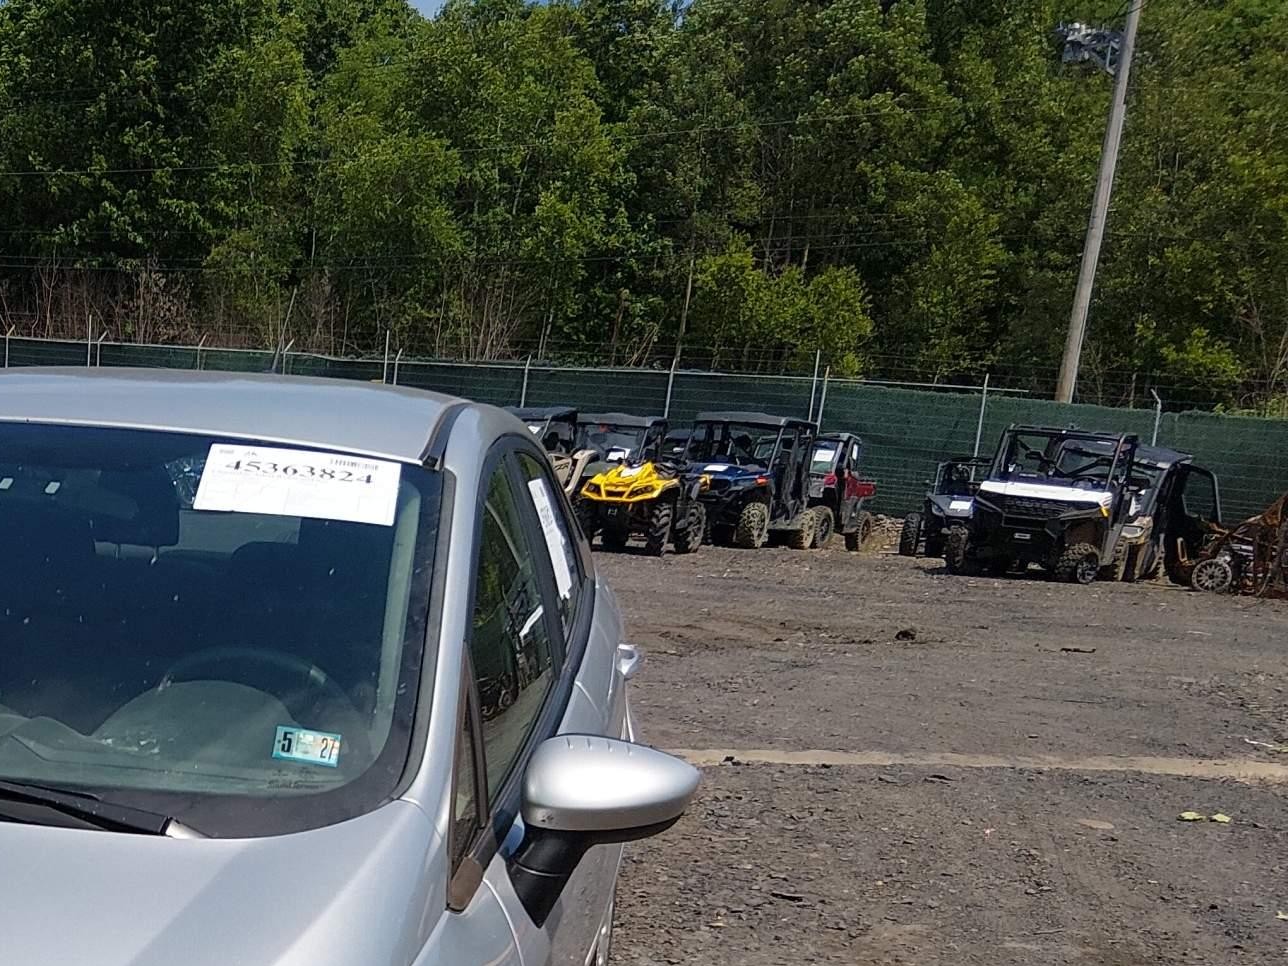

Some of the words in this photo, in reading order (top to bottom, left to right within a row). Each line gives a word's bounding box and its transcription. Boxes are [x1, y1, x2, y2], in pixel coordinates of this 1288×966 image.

[225, 459, 374, 485] 45363824
[280, 731, 294, 753] 5
[319, 737, 337, 762] 27
